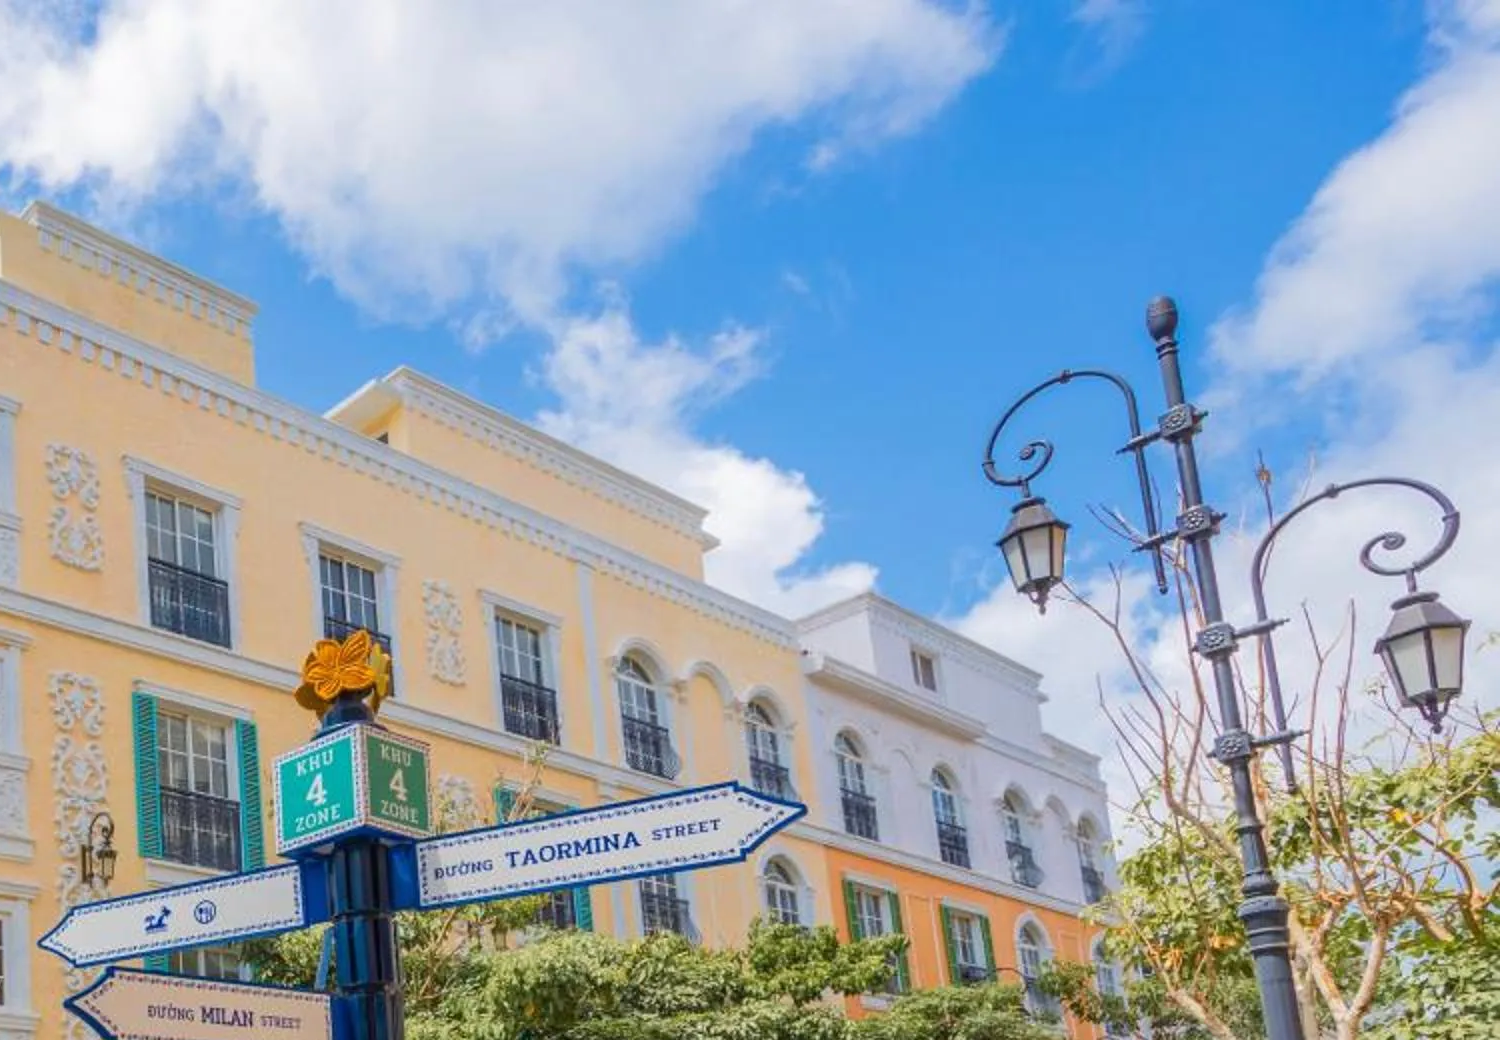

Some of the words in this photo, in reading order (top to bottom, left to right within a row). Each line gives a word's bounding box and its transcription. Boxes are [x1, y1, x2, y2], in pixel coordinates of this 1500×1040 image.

[297, 749, 334, 776] KHU
[380, 744, 413, 767] KHU
[306, 772, 328, 806] 4
[389, 768, 409, 801] 4
[295, 804, 342, 832] ZONE
[380, 800, 420, 825] ZONE
[505, 831, 642, 869] TAORMINA
[651, 818, 721, 841] STREET
[200, 1005, 254, 1027] MILAN
[260, 1015, 303, 1029] STREET
